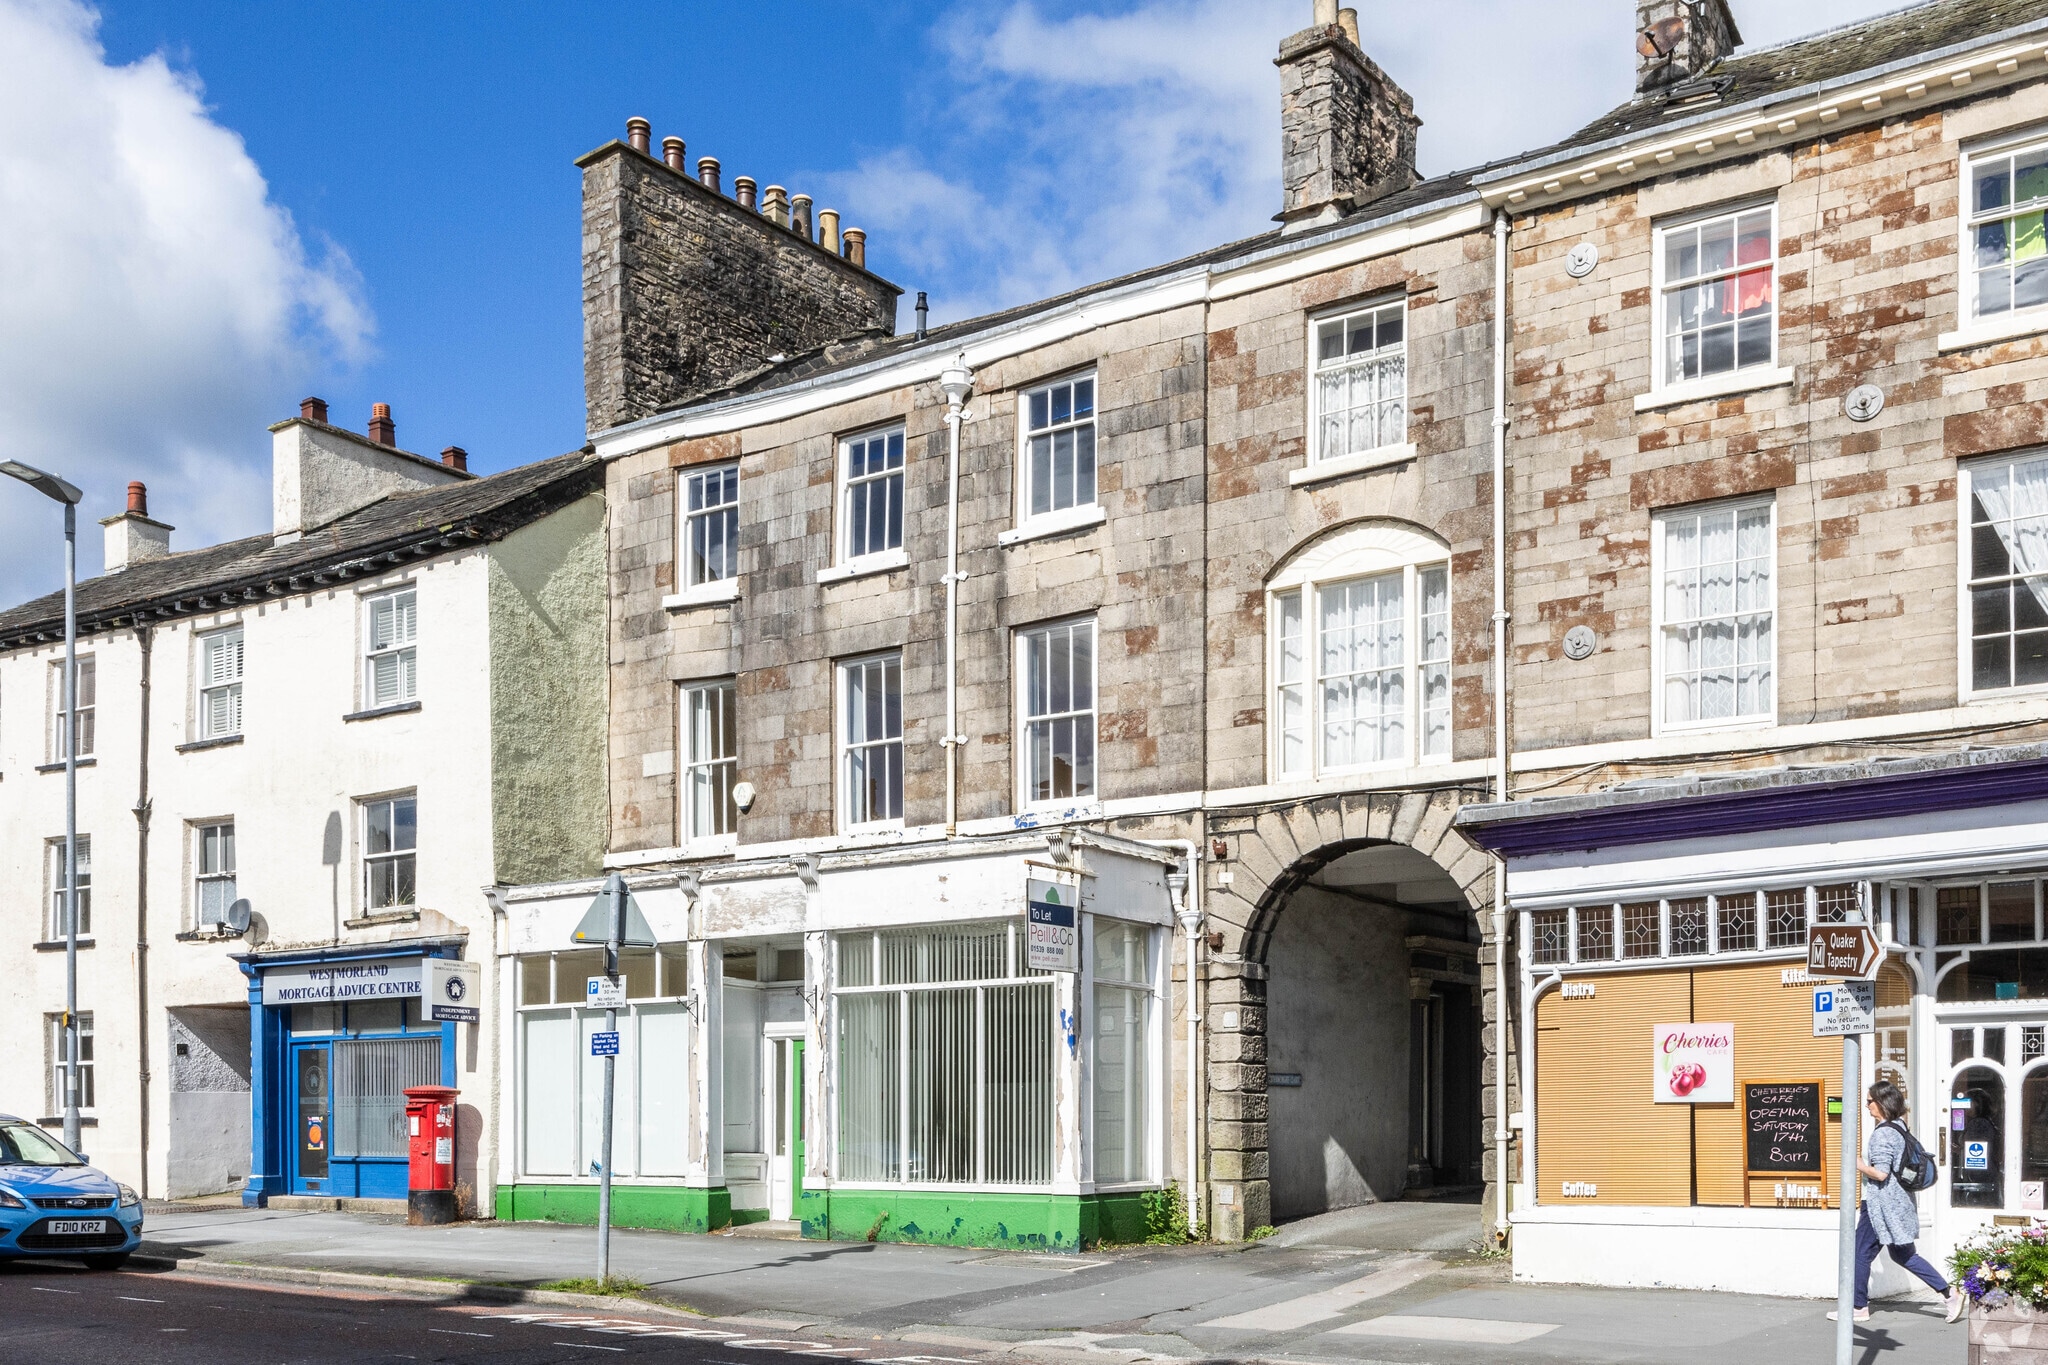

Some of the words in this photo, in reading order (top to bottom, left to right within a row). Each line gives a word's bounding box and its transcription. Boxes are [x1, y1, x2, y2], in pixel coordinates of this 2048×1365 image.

[1032, 908, 1039, 919] To
[1041, 910, 1052, 921] Let
[1830, 932, 1857, 949] Quaker
[1827, 952, 1858, 971] Tapestry
[309, 964, 388, 980] WESTMORLAND
[278, 986, 335, 1000] MORTGAGE
[337, 984, 376, 996] ADVICE
[379, 981, 421, 994] CENTRE
[1562, 983, 1595, 996] Bistro
[1663, 1032, 1730, 1053] Cherries
[1750, 1107, 1809, 1119] OPENING
[1753, 1120, 1808, 1132] SATURDAY
[1562, 1182, 1597, 1196] Coffee
[1774, 1184, 1783, 1198] &
[55, 1222, 78, 1232] FD10
